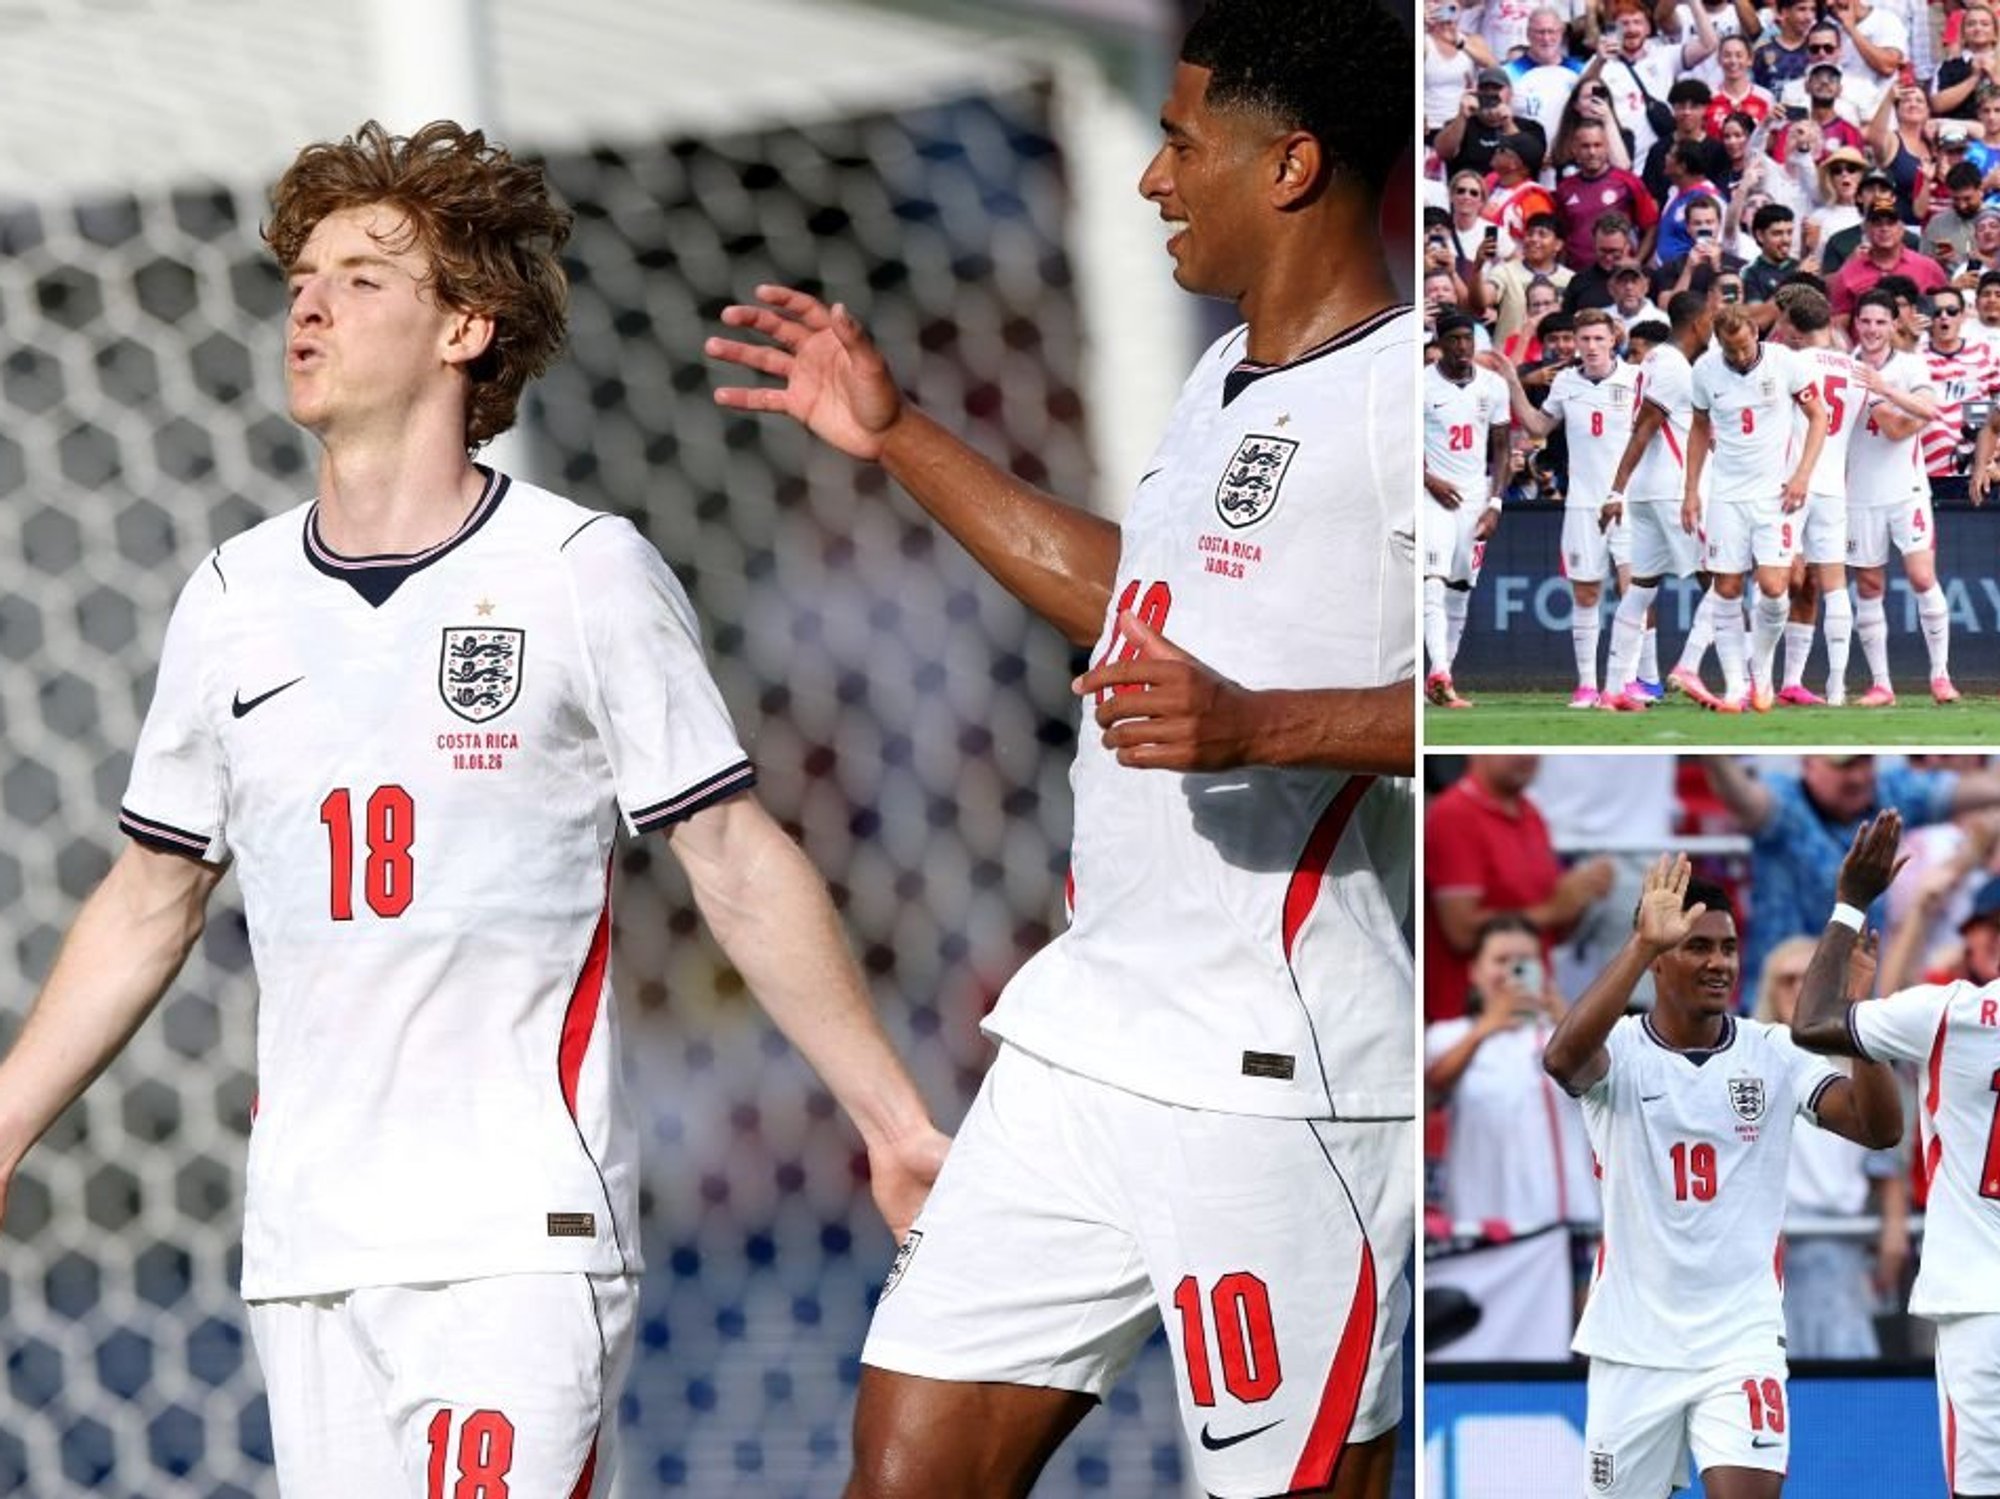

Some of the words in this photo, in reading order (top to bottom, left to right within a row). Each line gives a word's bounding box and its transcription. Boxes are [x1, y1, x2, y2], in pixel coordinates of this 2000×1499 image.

[1824, 375, 1847, 436] 5
[1591, 412, 1603, 437] 8
[1741, 408, 1754, 435] 9
[1450, 424, 1473, 451] 20
[1913, 508, 1926, 532] 4
[1198, 535, 1229, 555] COSTA
[1231, 541, 1262, 563] RICA
[1782, 523, 1793, 549] 9
[437, 734, 482, 750] COSTA
[486, 733, 519, 749] RICA
[320, 784, 415, 921] 18
[1670, 1142, 1717, 1201] 19
[1174, 1271, 1283, 1407] 10
[1742, 1377, 1785, 1433] 19
[427, 1408, 515, 1499] 18
